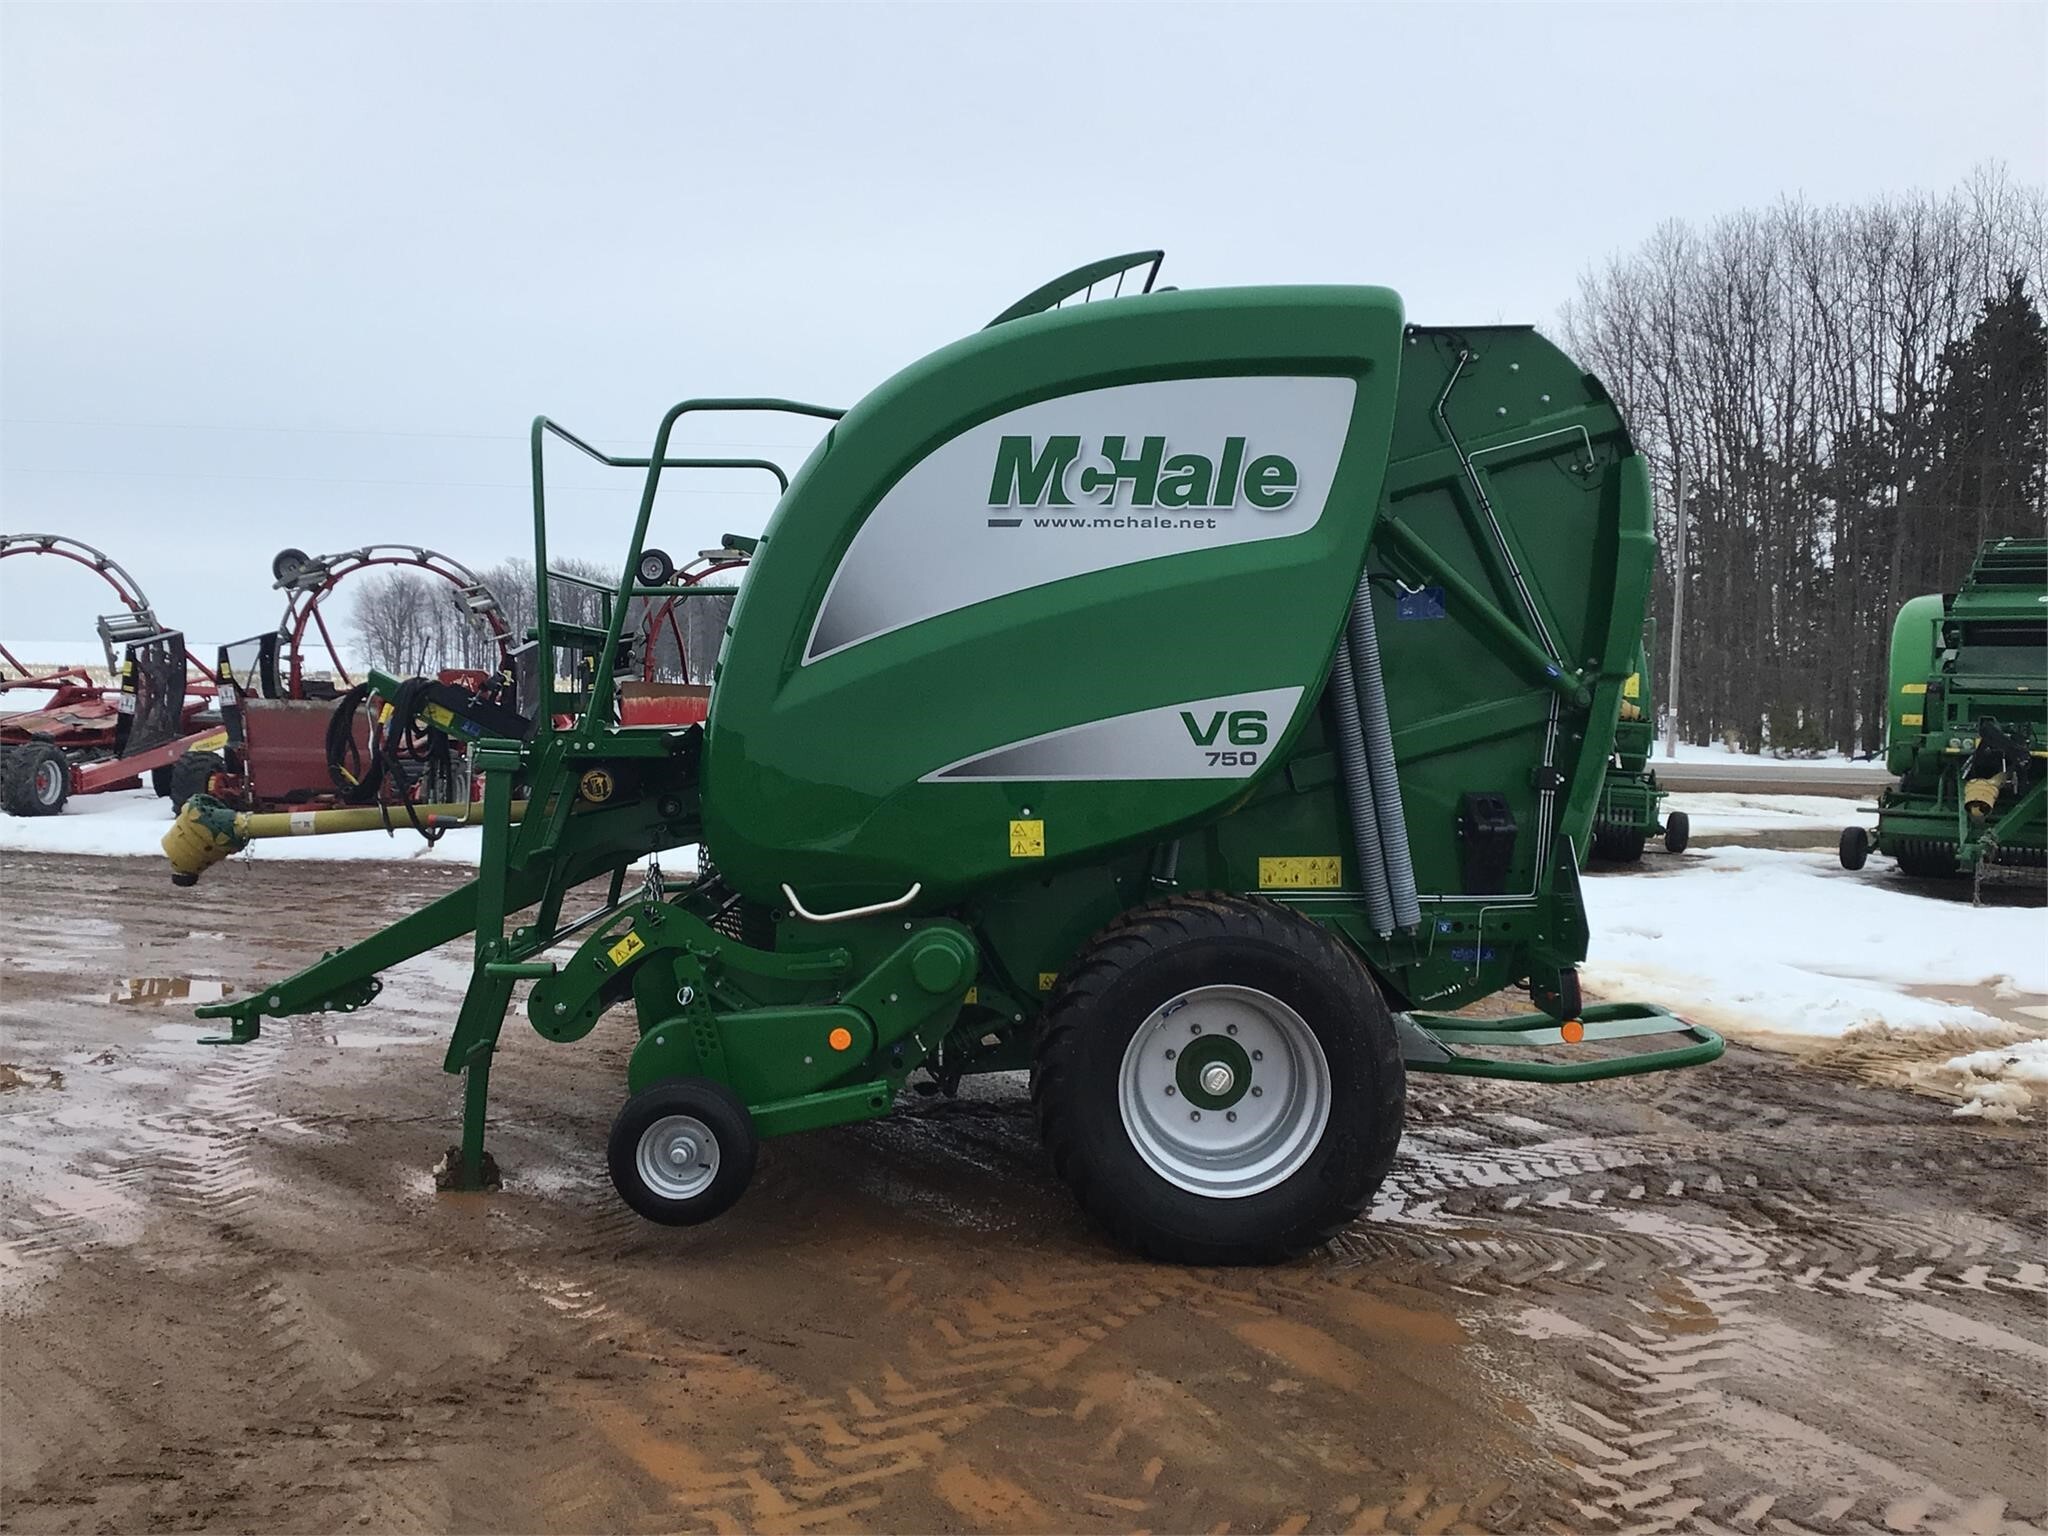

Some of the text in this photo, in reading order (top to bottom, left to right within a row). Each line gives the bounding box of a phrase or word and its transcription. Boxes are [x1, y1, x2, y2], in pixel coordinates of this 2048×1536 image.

[988, 435, 1298, 509] McHale
[1033, 516, 1217, 529] www.mchale.net
[1180, 710, 1268, 746] V6
[1205, 751, 1257, 767] 750
